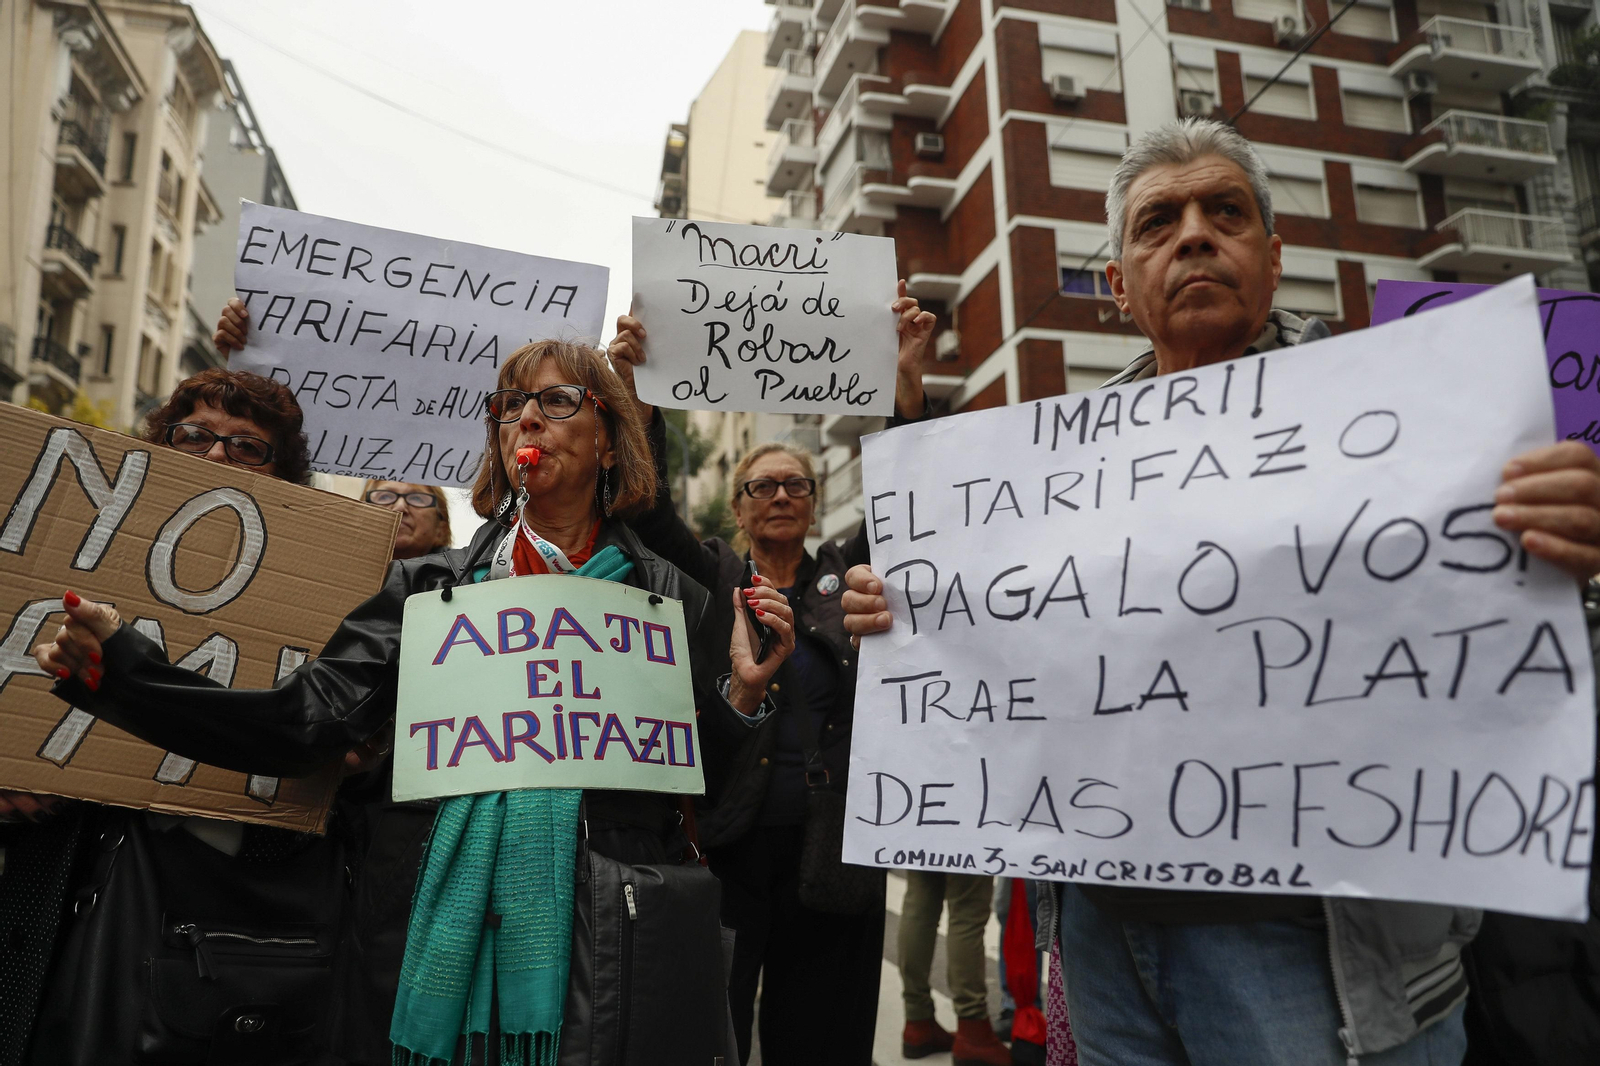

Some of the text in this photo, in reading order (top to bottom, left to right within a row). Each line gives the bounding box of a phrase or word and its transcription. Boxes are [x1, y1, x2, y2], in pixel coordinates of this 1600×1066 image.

[802, 281, 845, 318] de
[704, 321, 850, 369] Robar
[754, 368, 877, 406] Pueblo
[0, 426, 268, 615] NO
[871, 490, 936, 544] EL
[432, 607, 677, 666] ABAJO
[526, 659, 601, 699] EL
[881, 616, 1575, 724] TRAE LA PLATA
[1168, 759, 1595, 870] OFFSHORE
[874, 848, 977, 869] COMUNA
[1094, 860, 1311, 887] CRISTOBAL
